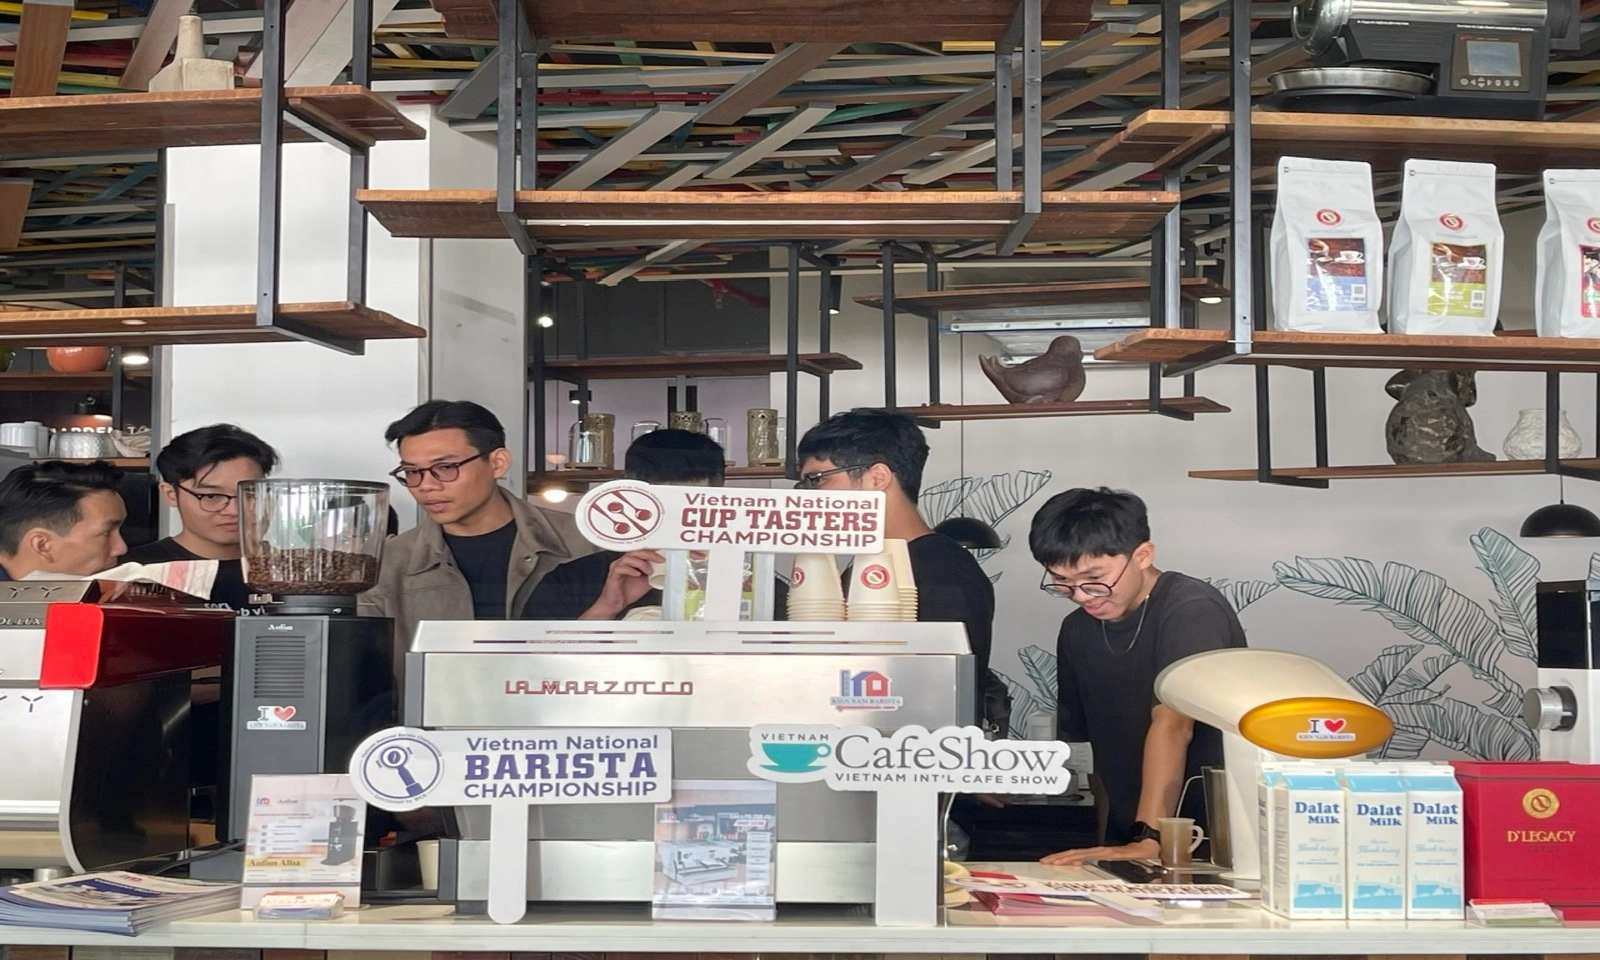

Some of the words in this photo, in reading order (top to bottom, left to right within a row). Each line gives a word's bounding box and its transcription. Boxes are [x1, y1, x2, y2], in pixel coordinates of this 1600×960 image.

[684, 492, 777, 508] Vietnam
[785, 495, 879, 510] National
[681, 507, 737, 529] CUP
[748, 509, 879, 532] TASTERS
[680, 529, 877, 548] CHAMPIONSHIP
[260, 707, 269, 721] I
[1310, 719, 1319, 733] I
[466, 737, 558, 752] Vietnam
[566, 734, 658, 750] National
[761, 733, 829, 741] VIETNAM
[835, 733, 1058, 772] CafeShow
[465, 752, 657, 781] BARISTA
[835, 773, 906, 783] VIETNAM
[914, 773, 955, 783] INT'L
[962, 775, 1004, 784] CAFE
[1011, 775, 1058, 785] SHOW
[464, 781, 657, 798] CHAMPIONSHIP
[1295, 802, 1340, 814] Dalat
[1356, 804, 1402, 816] Dalat
[1412, 802, 1458, 815] Dalat
[1308, 815, 1340, 824] Milk
[1370, 817, 1402, 826] Milk
[1426, 816, 1458, 825] Milk
[1507, 830, 1577, 842] D'LEGACY
